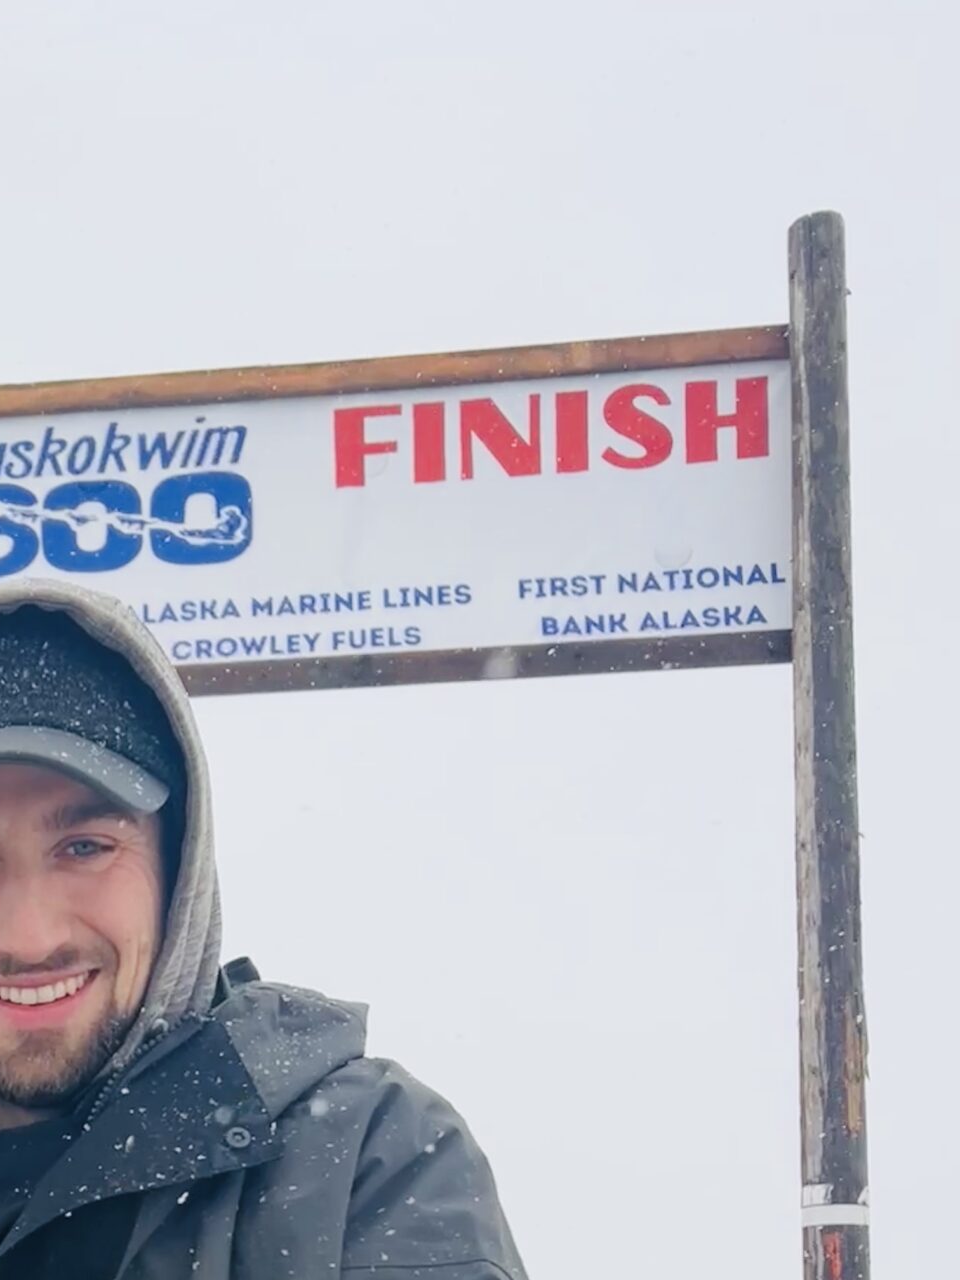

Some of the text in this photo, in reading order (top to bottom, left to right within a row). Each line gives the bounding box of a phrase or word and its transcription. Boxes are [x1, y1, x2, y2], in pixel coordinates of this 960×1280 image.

[334, 376, 769, 488] FINISH
[518, 562, 787, 600] FIRST NATIONAL
[130, 584, 473, 624] LASKA MARINE LINES
[541, 604, 769, 637] BANK ALASKA
[171, 626, 423, 661] CROWLEY FUELS
